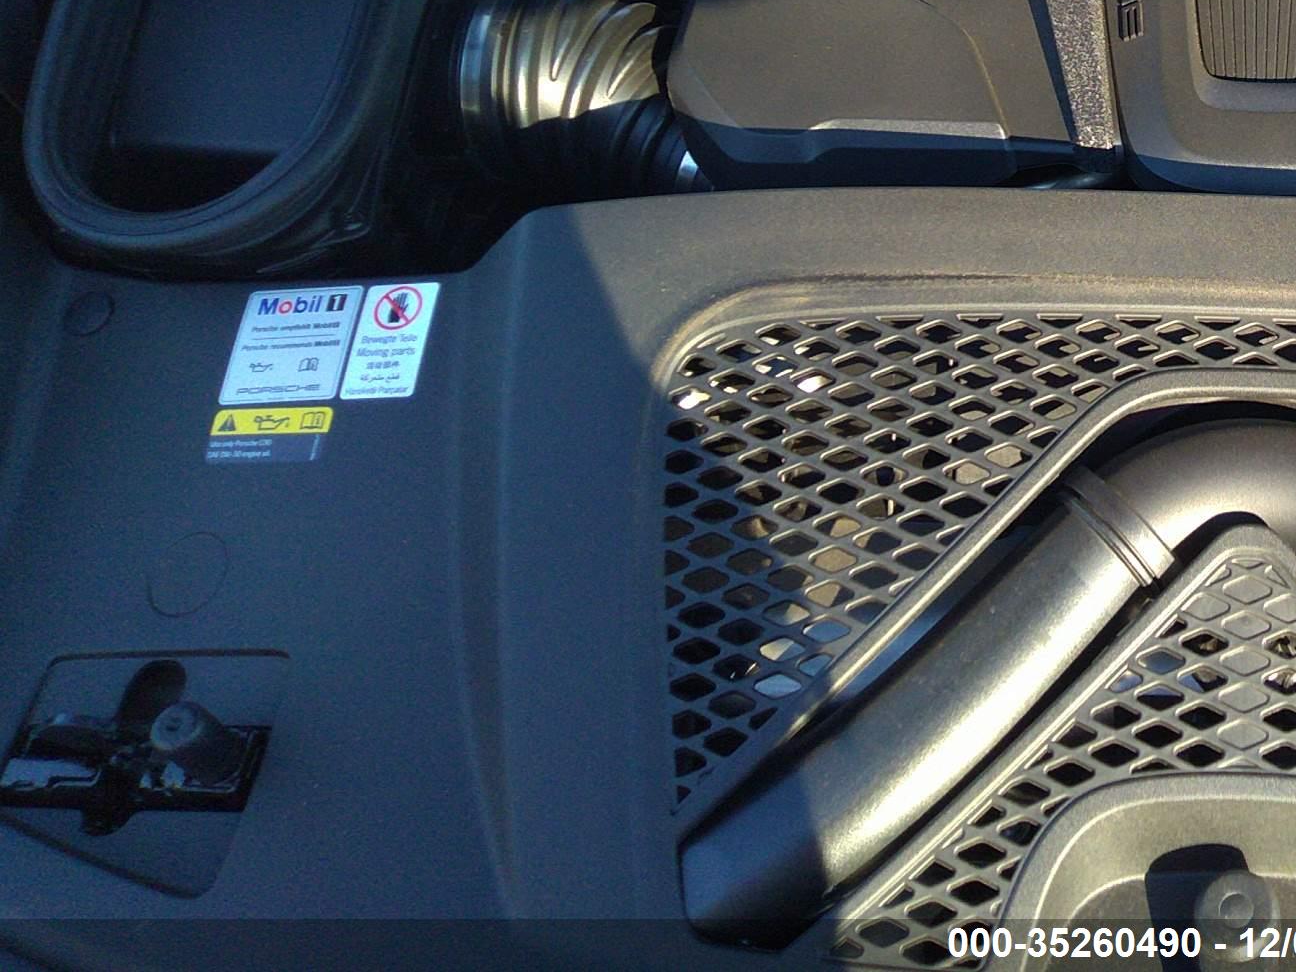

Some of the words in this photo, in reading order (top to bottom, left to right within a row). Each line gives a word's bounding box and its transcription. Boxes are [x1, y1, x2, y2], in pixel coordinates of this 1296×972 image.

[257, 295, 322, 316] Mobil
[326, 293, 348, 312] 1
[357, 348, 389, 358] Moving
[236, 383, 321, 395] PORSCHE
